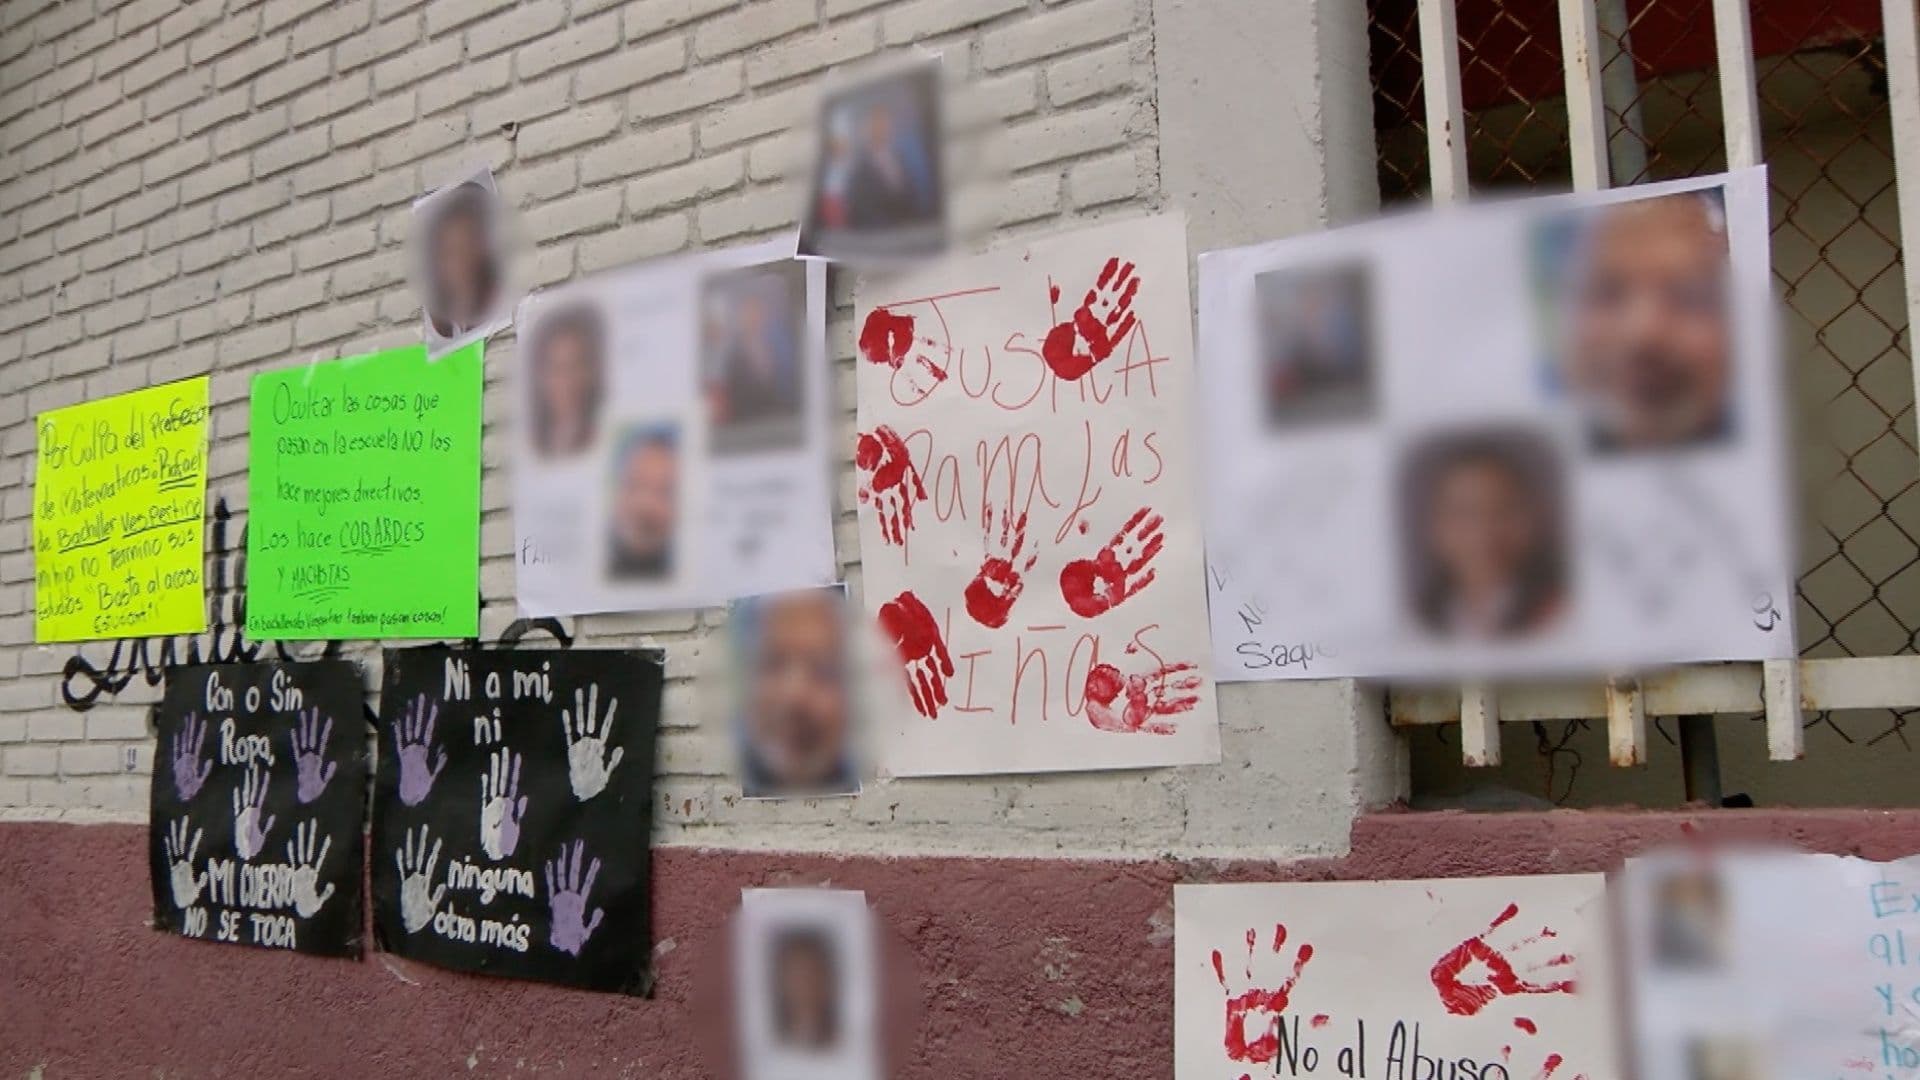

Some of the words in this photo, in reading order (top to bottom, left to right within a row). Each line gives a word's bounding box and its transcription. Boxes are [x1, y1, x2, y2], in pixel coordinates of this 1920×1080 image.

[273, 382, 335, 425] Ocultar
[342, 383, 360, 413] las
[364, 394, 407, 413] cosas
[413, 393, 440, 422] que
[124, 405, 145, 450] del
[313, 439, 329, 456] en
[333, 429, 347, 455] la
[349, 427, 399, 451] escuela
[401, 430, 424, 452] NO
[430, 427, 451, 452] los
[276, 476, 299, 502] hace
[303, 484, 350, 517] mejores
[297, 519, 331, 548] hace
[339, 517, 425, 549] COBARDES
[147, 566, 160, 593] al
[206, 669, 234, 713] Con
[271, 668, 302, 711] Sin
[444, 657, 470, 700] Ni
[485, 670, 500, 697] a
[513, 661, 553, 704] mi
[474, 707, 501, 745] ni
[208, 857, 235, 906] MI
[448, 855, 535, 905] ninguna
[183, 906, 208, 938] NO
[217, 910, 241, 942] SE
[250, 913, 296, 950] TOCA
[434, 901, 476, 943] otra
[1276, 1015, 1319, 1076] No
[1337, 1019, 1366, 1079] al
